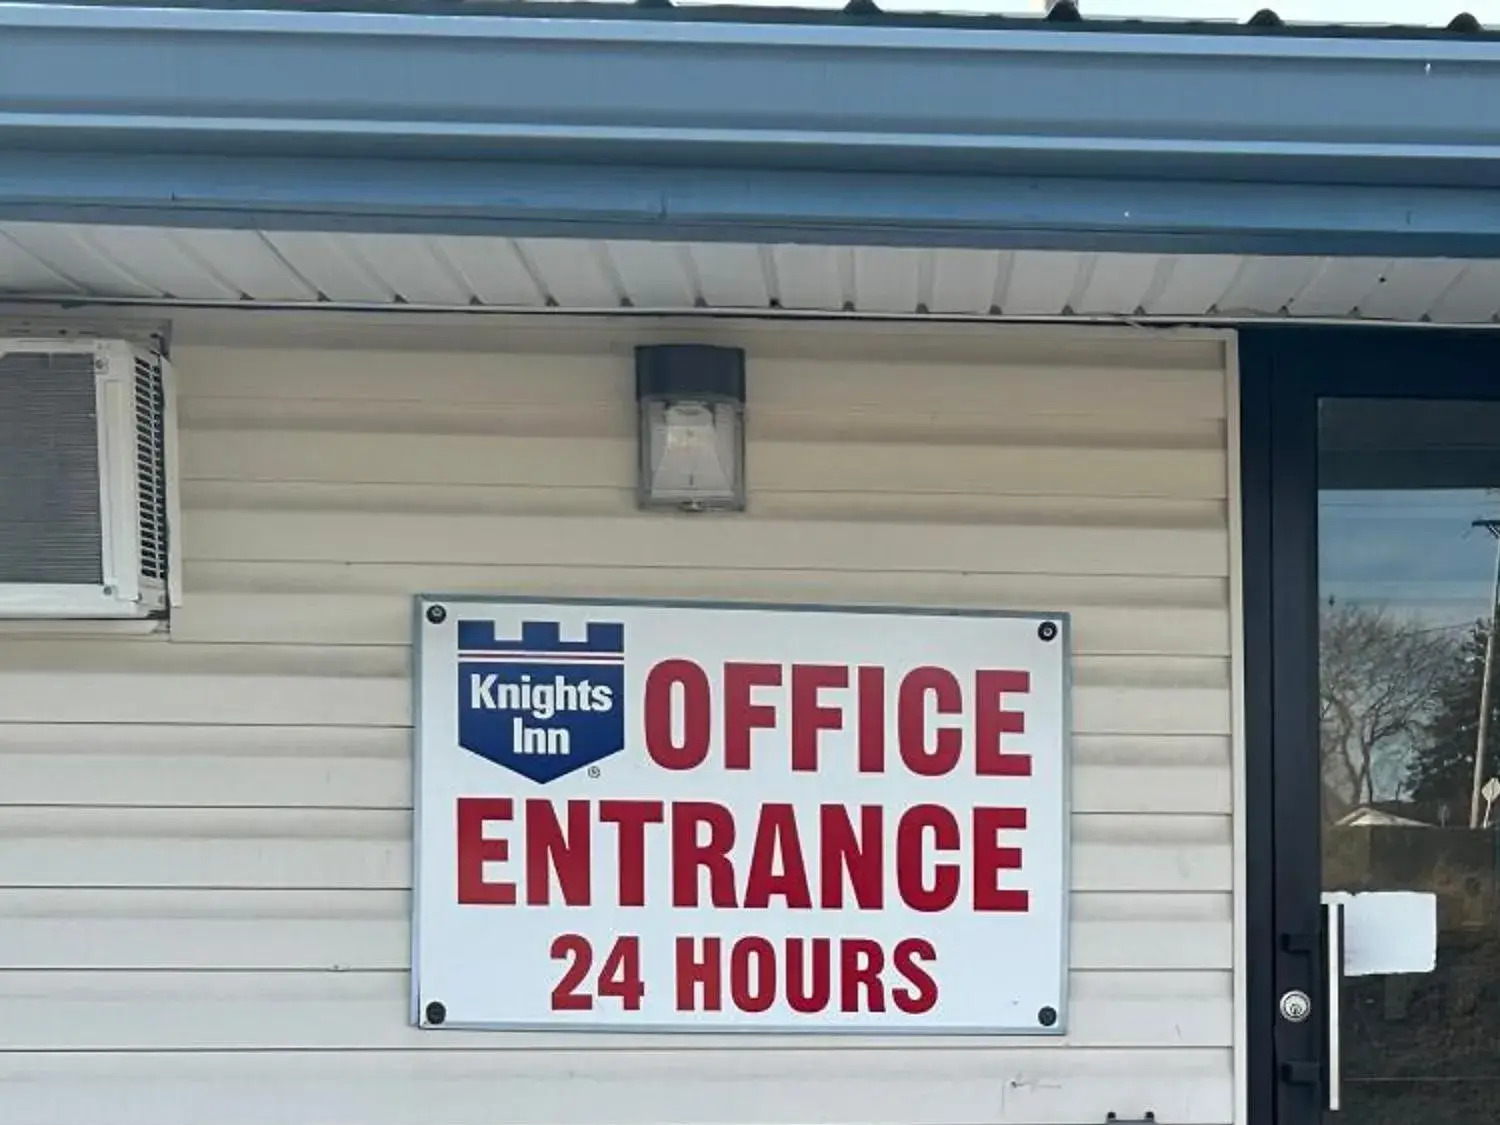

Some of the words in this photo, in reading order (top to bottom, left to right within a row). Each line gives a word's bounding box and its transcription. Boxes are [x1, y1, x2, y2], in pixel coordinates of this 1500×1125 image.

[471, 673, 613, 719] Knights
[514, 716, 569, 754] Inn
[644, 658, 1031, 776] OFFICE
[457, 798, 1029, 912] ENTRANCE
[550, 933, 644, 1011] 24
[676, 937, 937, 1013] HOURS
